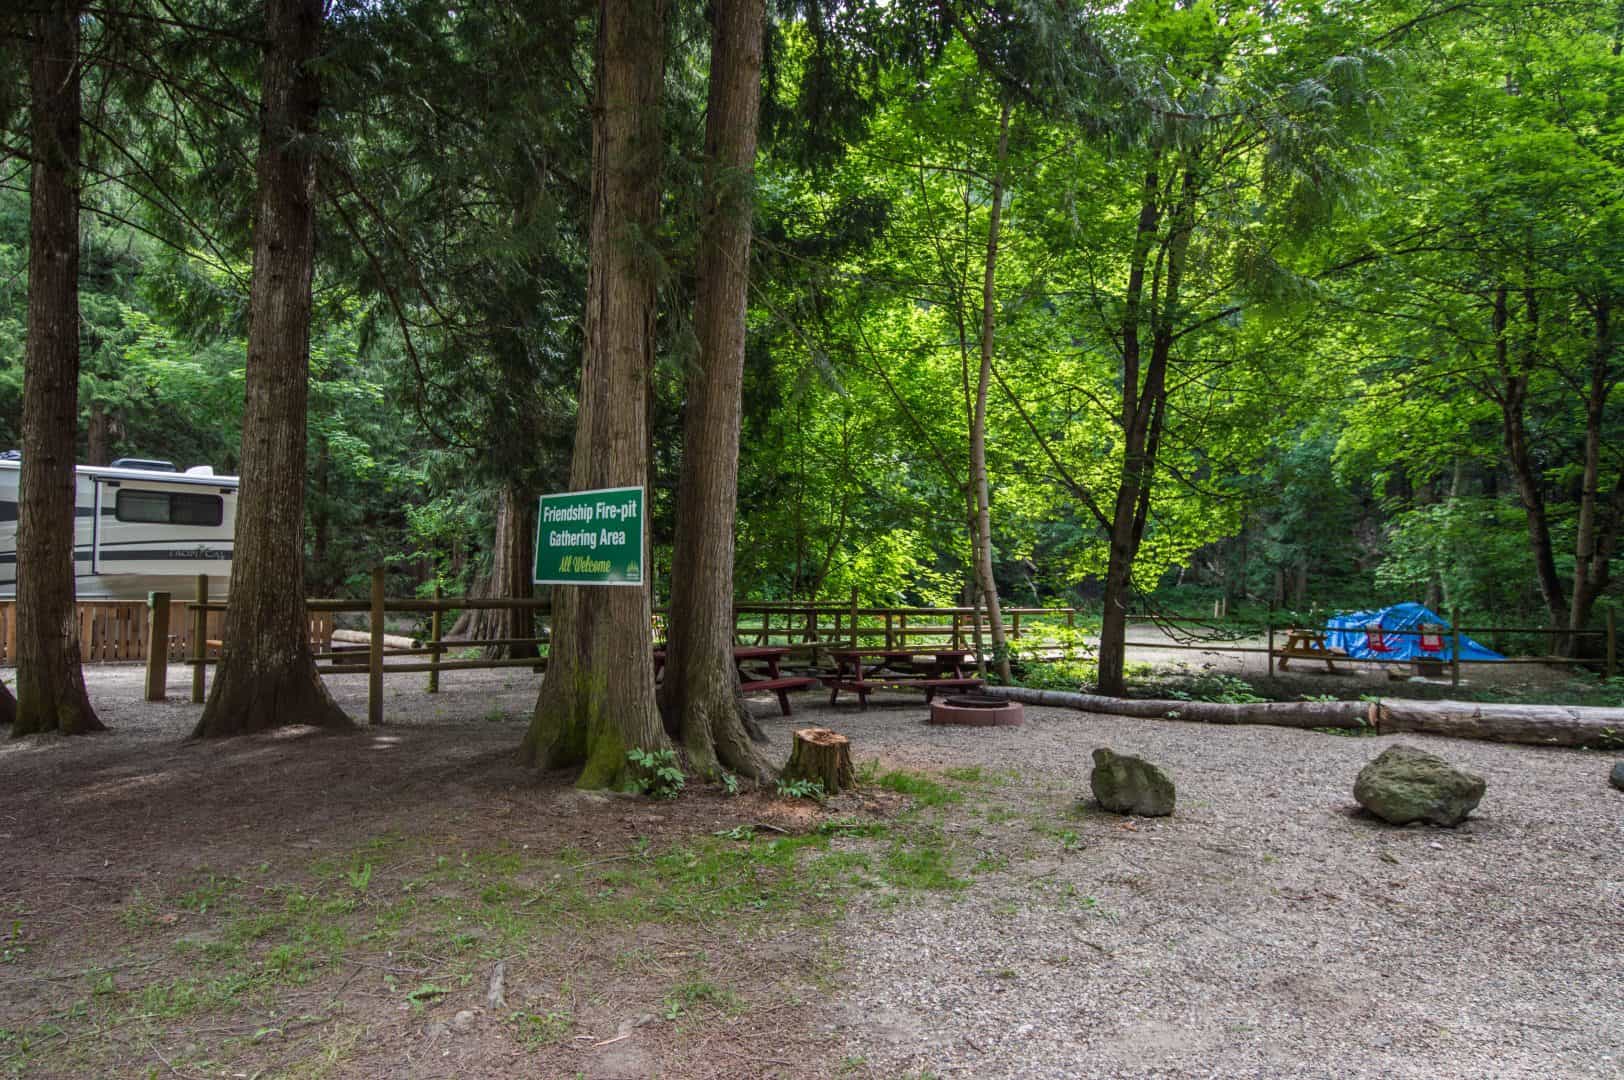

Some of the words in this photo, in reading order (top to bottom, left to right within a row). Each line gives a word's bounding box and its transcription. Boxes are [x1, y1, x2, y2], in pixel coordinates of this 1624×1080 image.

[543, 504, 593, 523] Friendship
[595, 500, 637, 521] Fire-pit
[549, 529, 597, 549] Gathering
[599, 528, 626, 545] Area
[559, 555, 573, 573] All
[573, 556, 611, 573] Welcome
